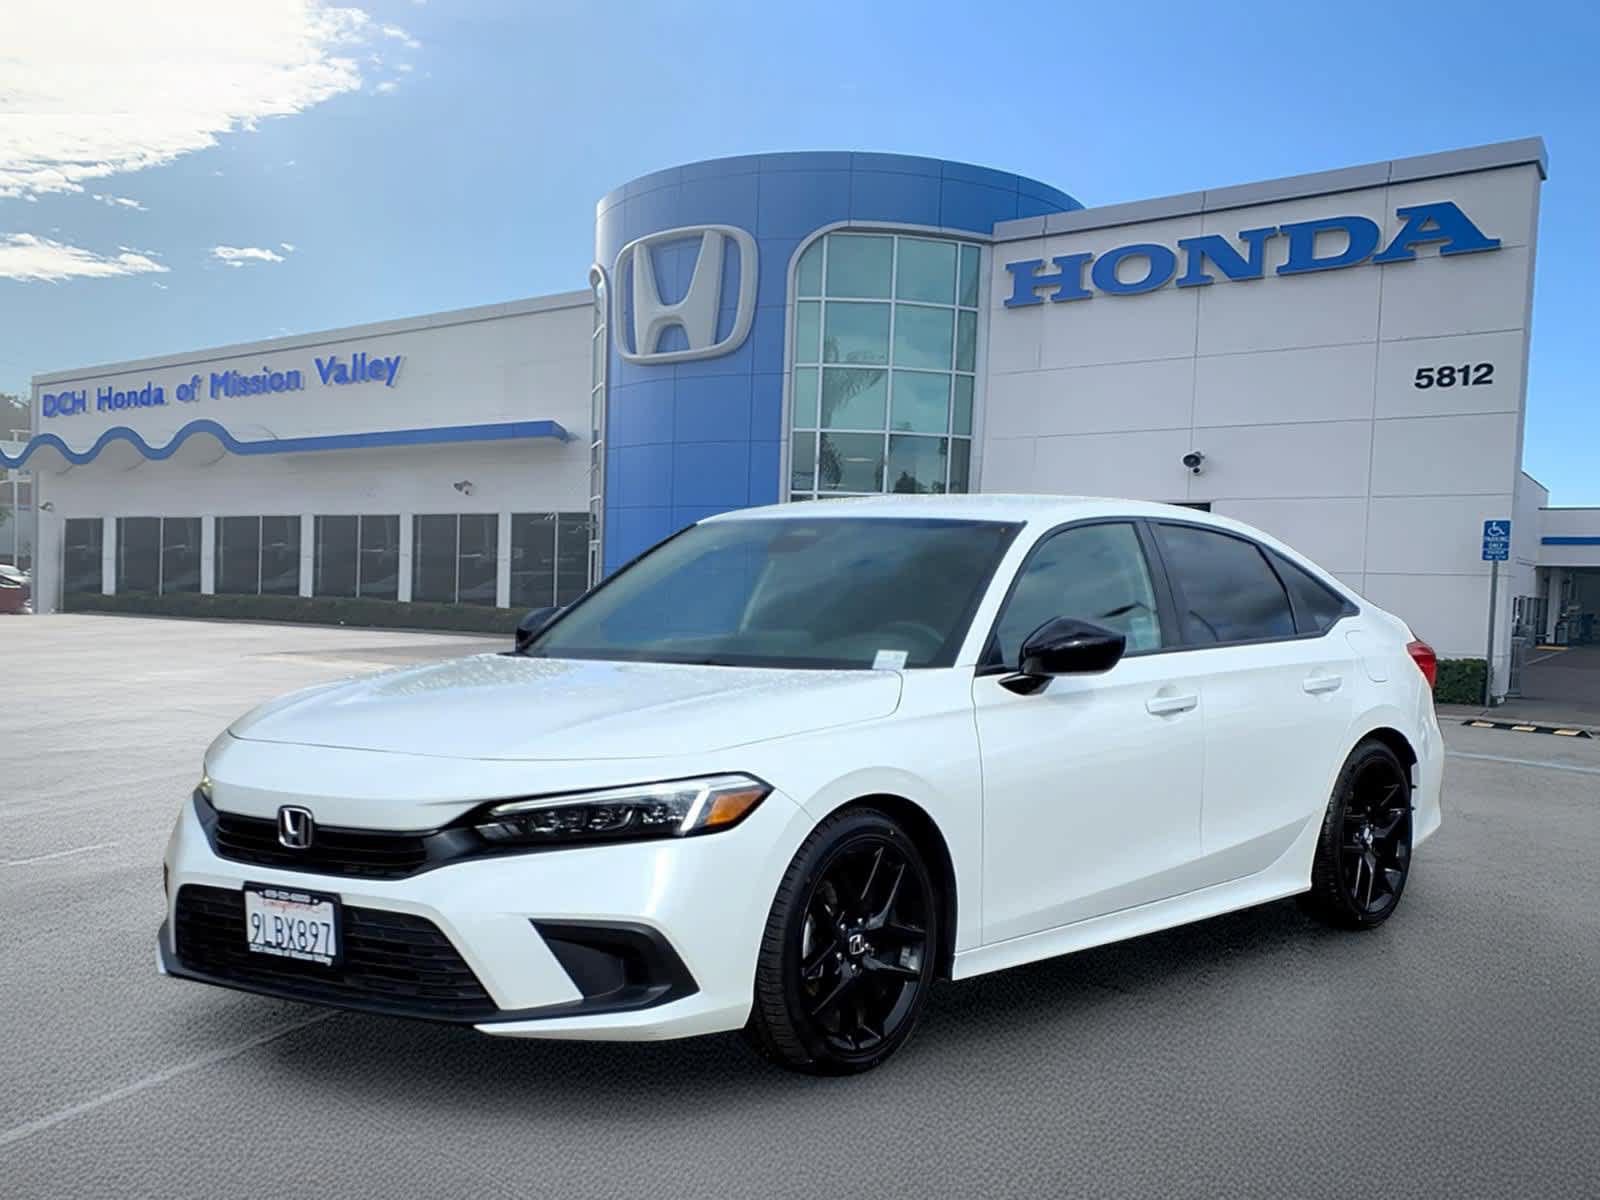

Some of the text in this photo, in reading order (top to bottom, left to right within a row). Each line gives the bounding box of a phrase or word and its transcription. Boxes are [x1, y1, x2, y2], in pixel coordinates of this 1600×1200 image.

[1003, 200, 1501, 308] HONDA
[43, 352, 402, 417] DCH Honda of Mission Valley
[1414, 363, 1495, 389] 5812
[250, 911, 332, 956] 9LBX897
